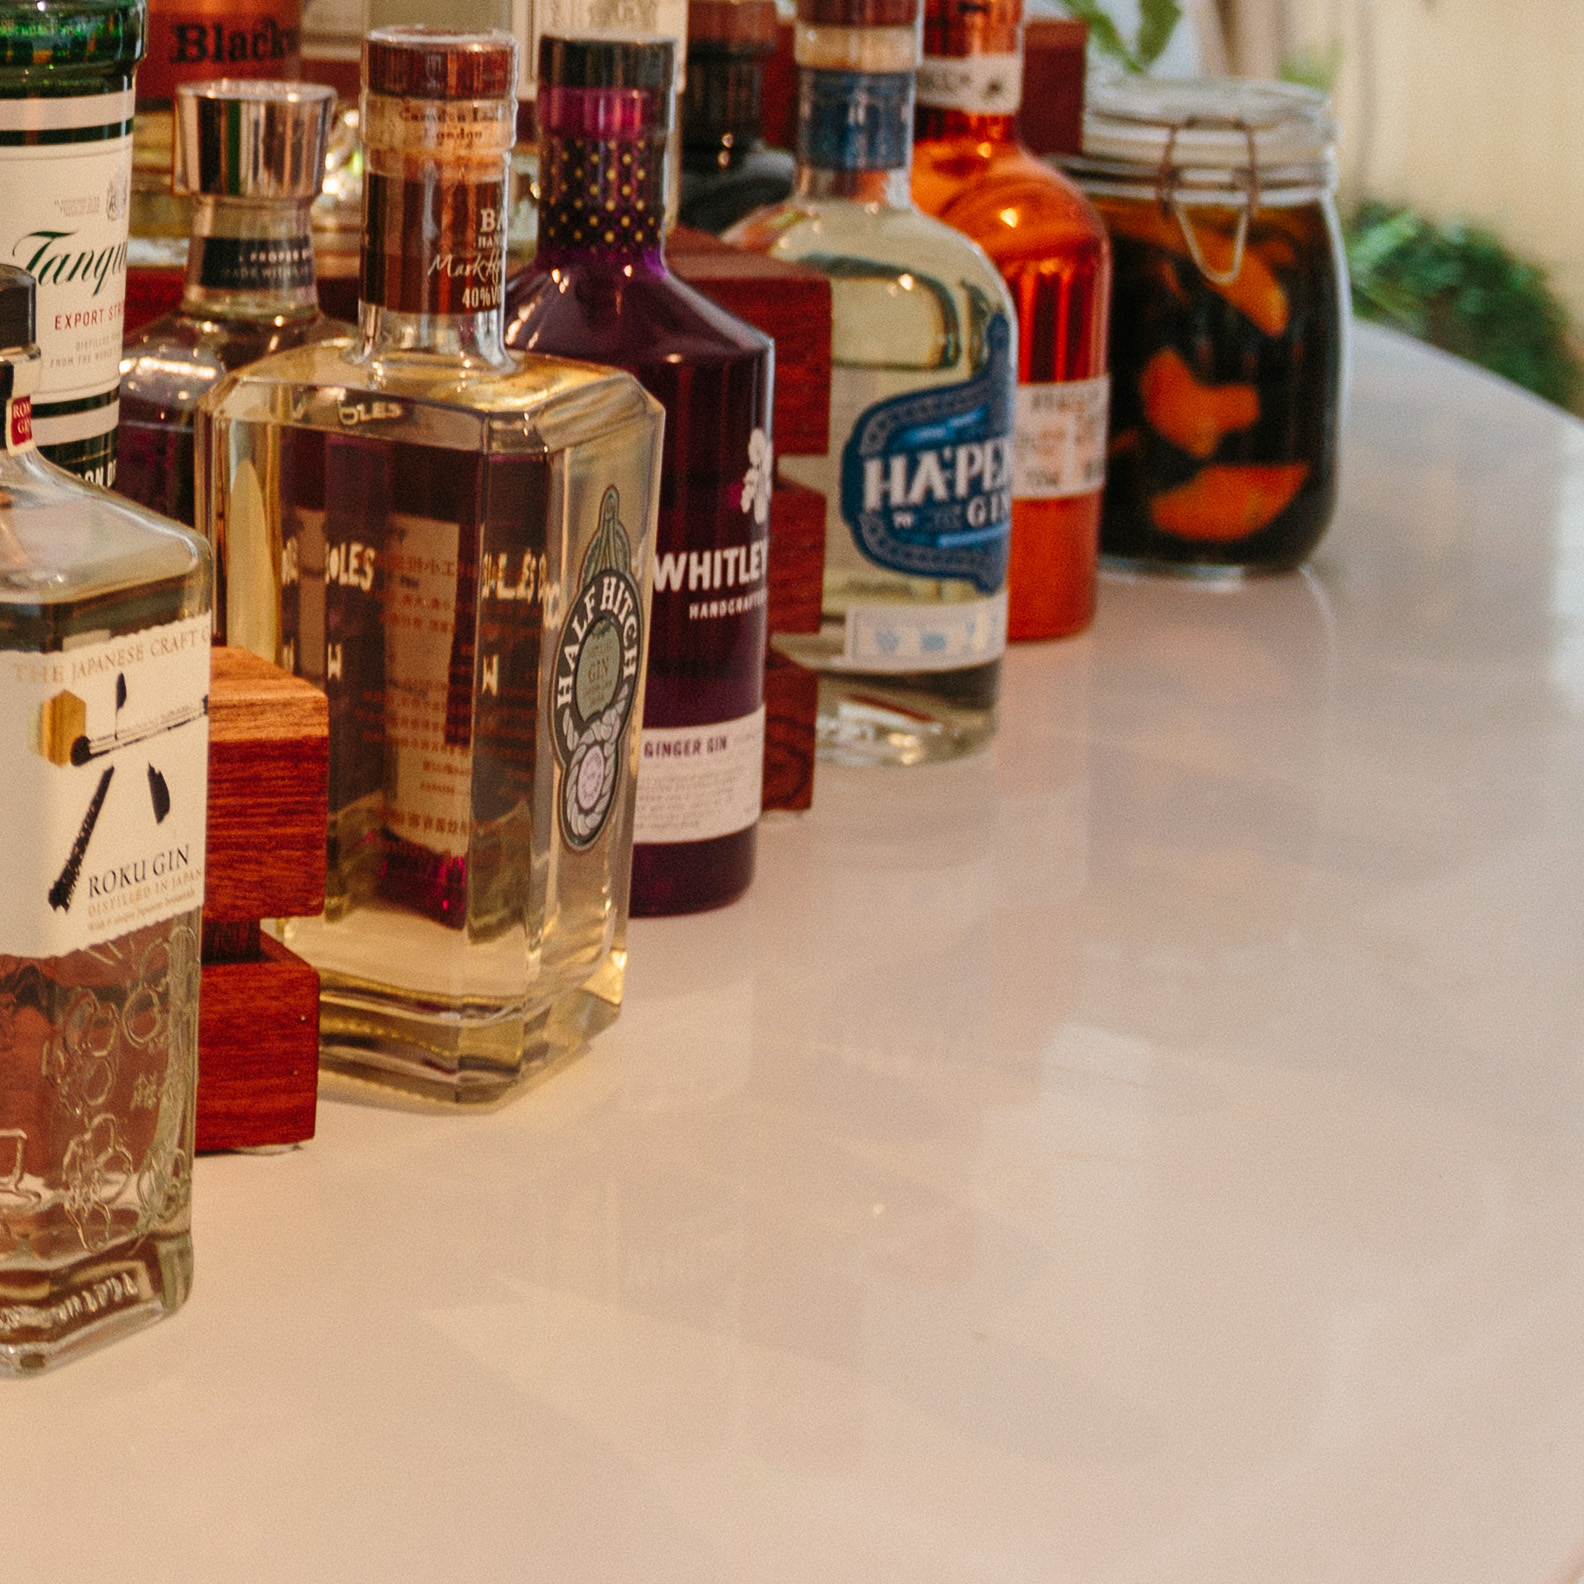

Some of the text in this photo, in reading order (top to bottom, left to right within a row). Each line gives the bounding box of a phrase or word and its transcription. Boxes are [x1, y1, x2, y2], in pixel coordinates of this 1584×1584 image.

[54, 308, 105, 331] EXPORT
[14, 624, 199, 686] THE JAPANESE CRAFT
[556, 575, 638, 709] HALF HITCH
[643, 735, 728, 759] GINGER GIN
[88, 842, 190, 899] ROKU GIN
